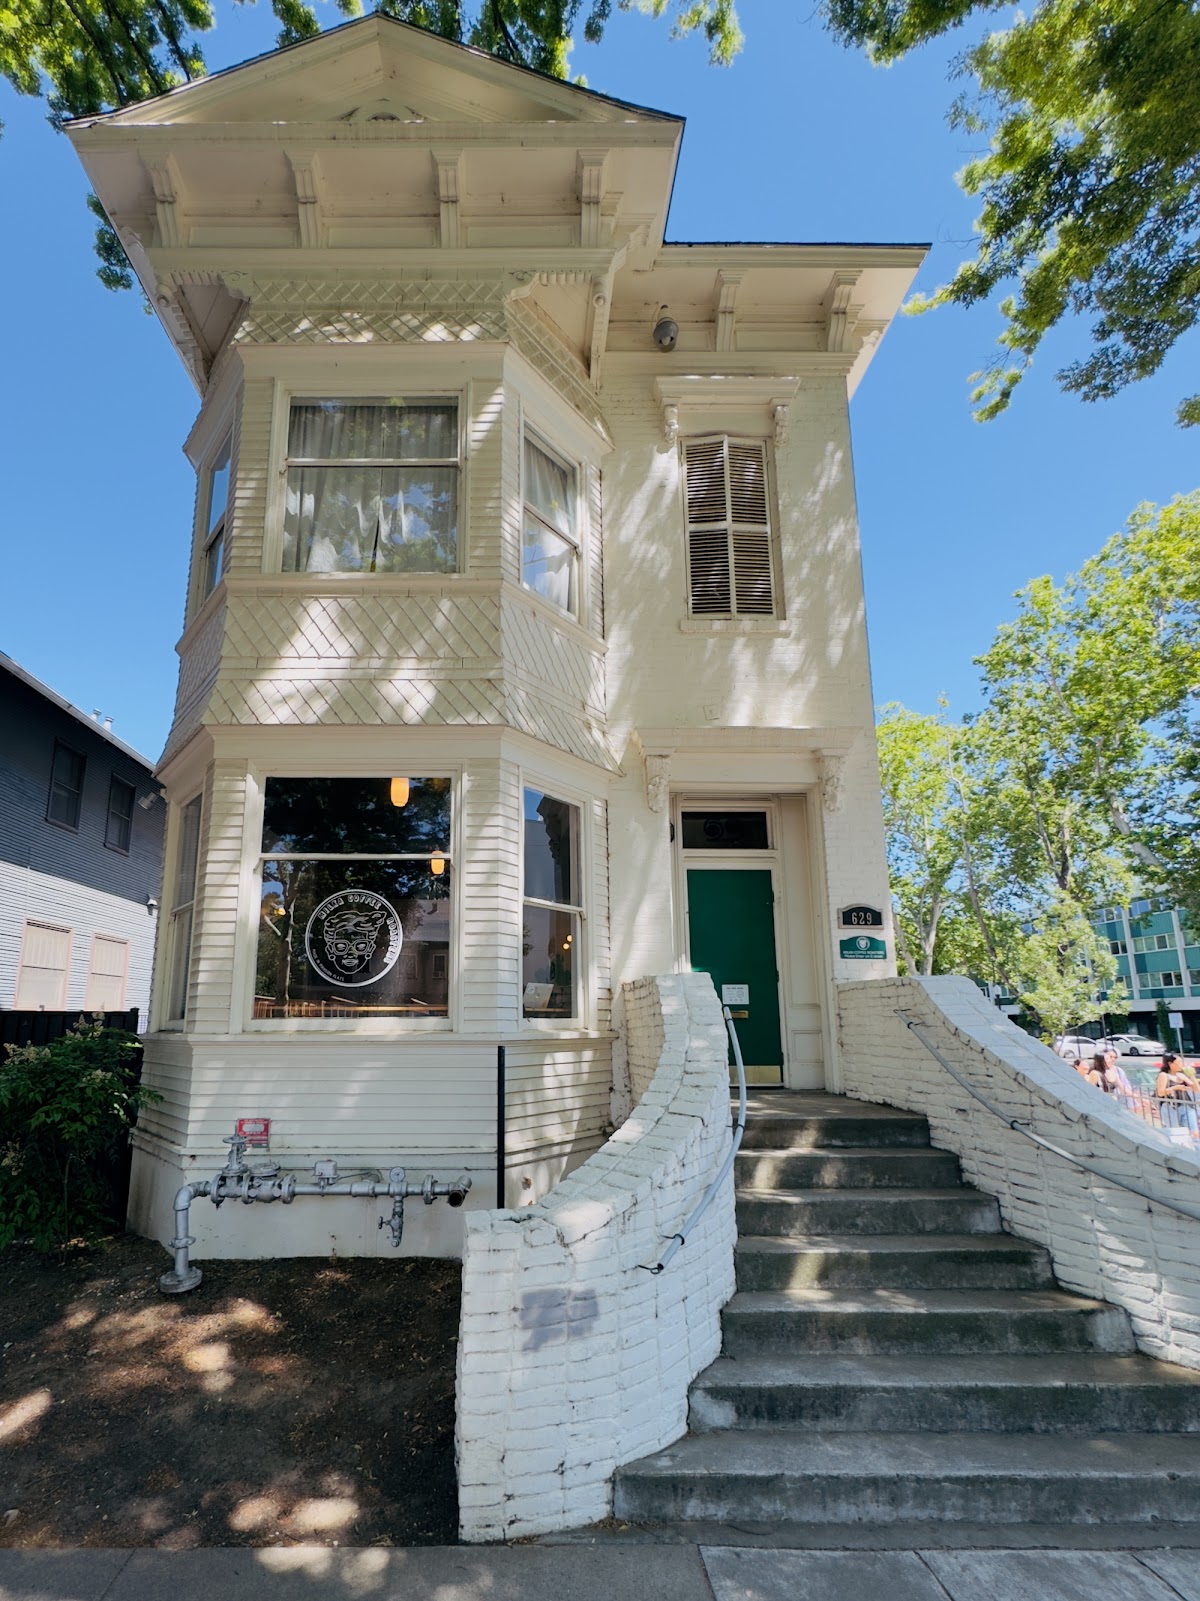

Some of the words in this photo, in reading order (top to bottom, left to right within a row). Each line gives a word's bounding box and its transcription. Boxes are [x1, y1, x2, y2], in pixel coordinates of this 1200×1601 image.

[318, 897, 345, 920] MILKA
[347, 894, 382, 910] COFFEE
[383, 917, 399, 964] ROASTERS
[852, 912, 872, 924] 629
